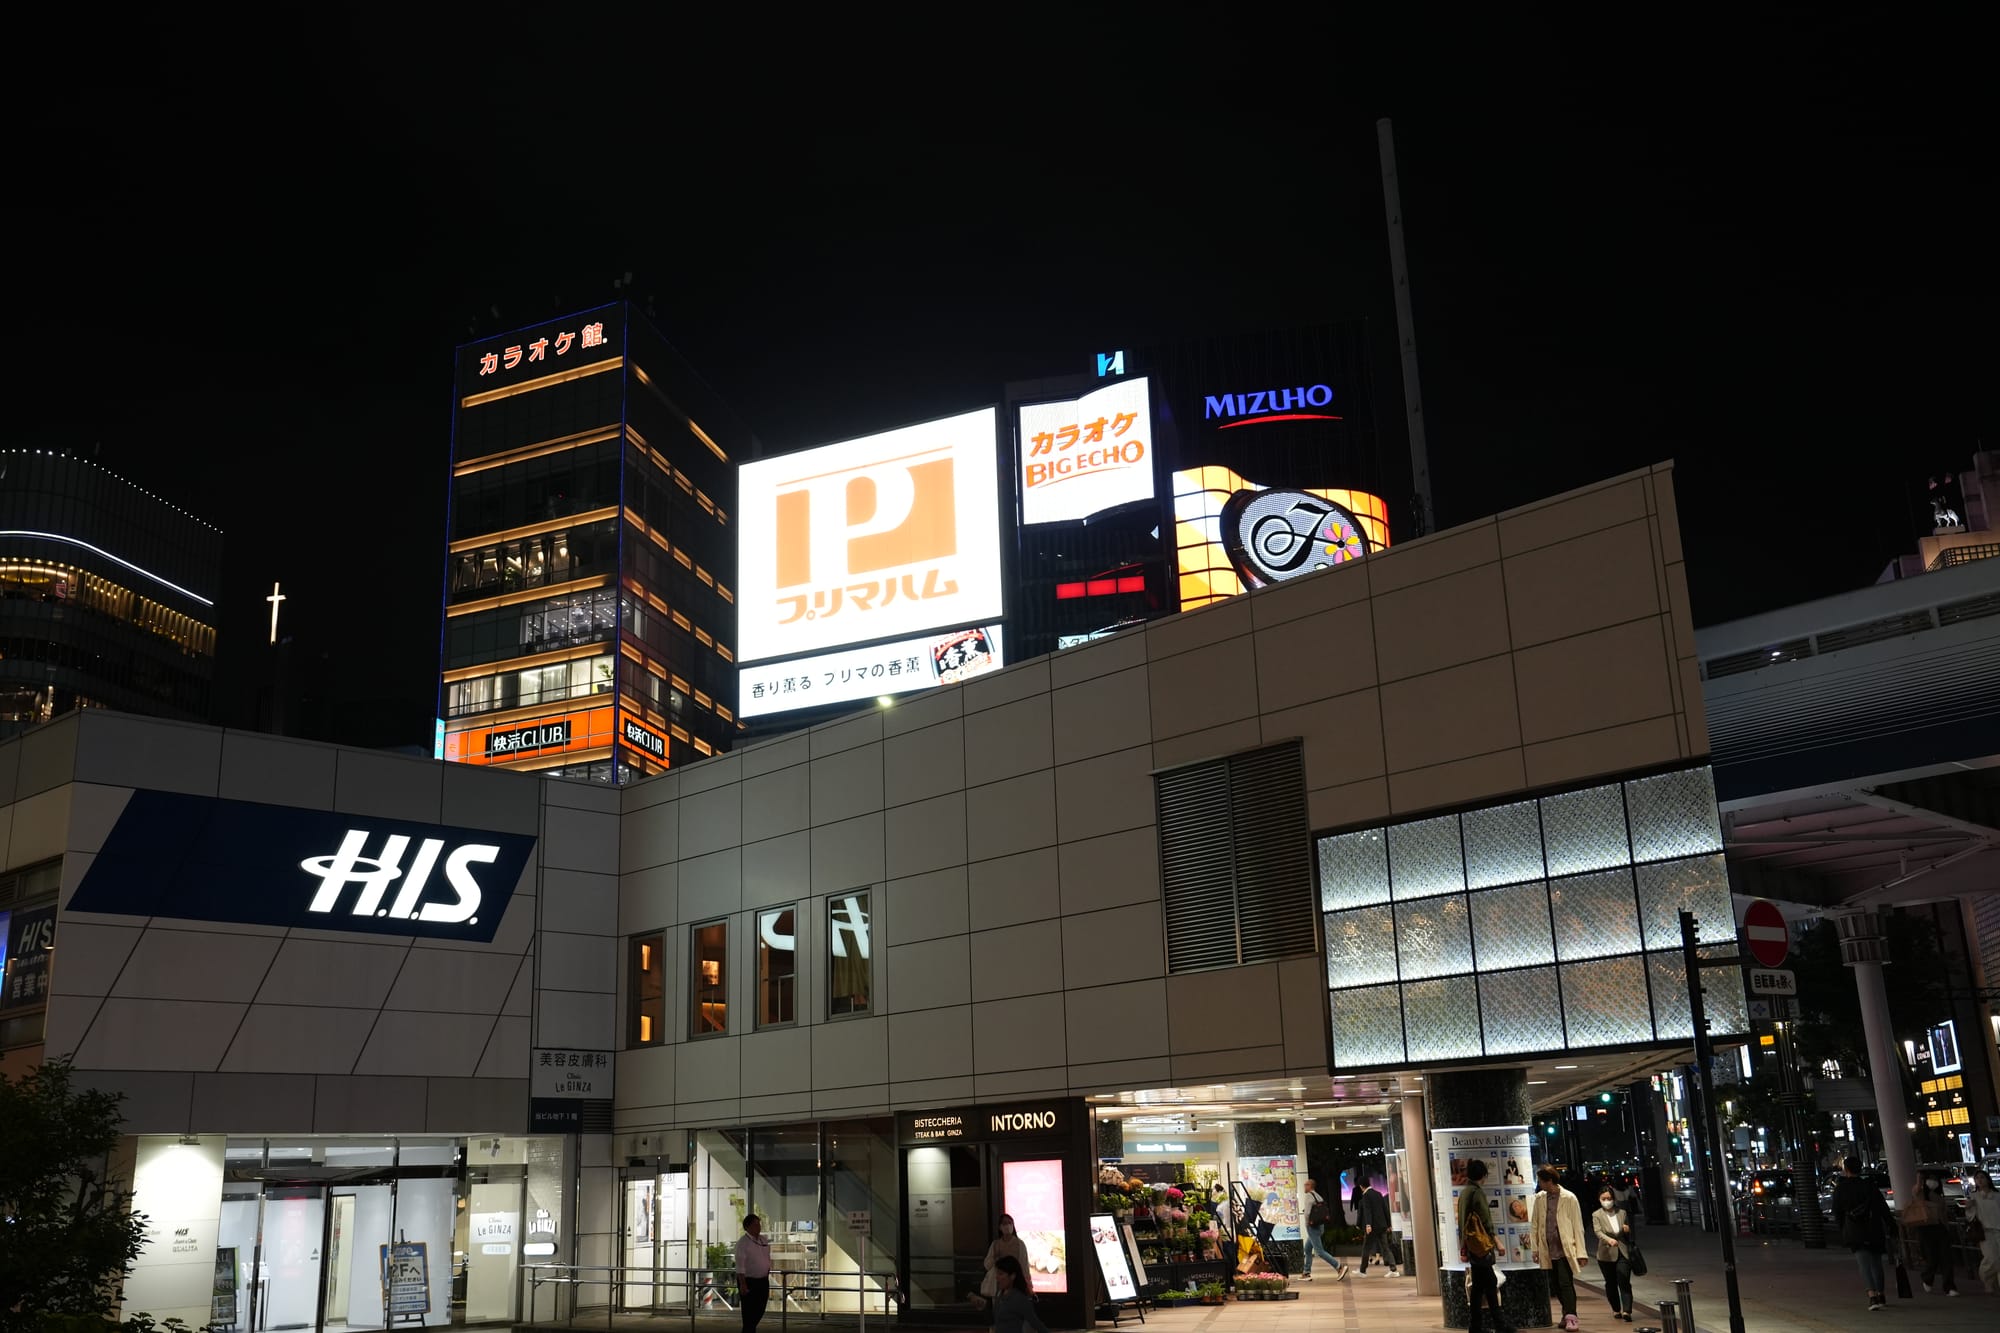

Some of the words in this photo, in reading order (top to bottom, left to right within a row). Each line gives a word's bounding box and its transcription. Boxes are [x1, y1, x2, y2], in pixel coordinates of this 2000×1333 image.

[1204, 384, 1333, 419] MIZUHO
[1030, 412, 1138, 457] カラオケ
[1026, 458, 1072, 488] BIG
[1076, 440, 1144, 470] ECHO
[776, 569, 959, 624] プリマハム
[752, 676, 812, 698] 香り薫る
[824, 656, 920, 686] プリマの香薫
[494, 726, 563, 752] 快活CLUB
[540, 1053, 607, 1068] 美容皮膚科
[567, 1081, 591, 1093] GINZA
[914, 1117, 962, 1128] BISTECCHERIA
[991, 1111, 1056, 1131] INTORNO
[1451, 1137, 1485, 1146] Beauty
